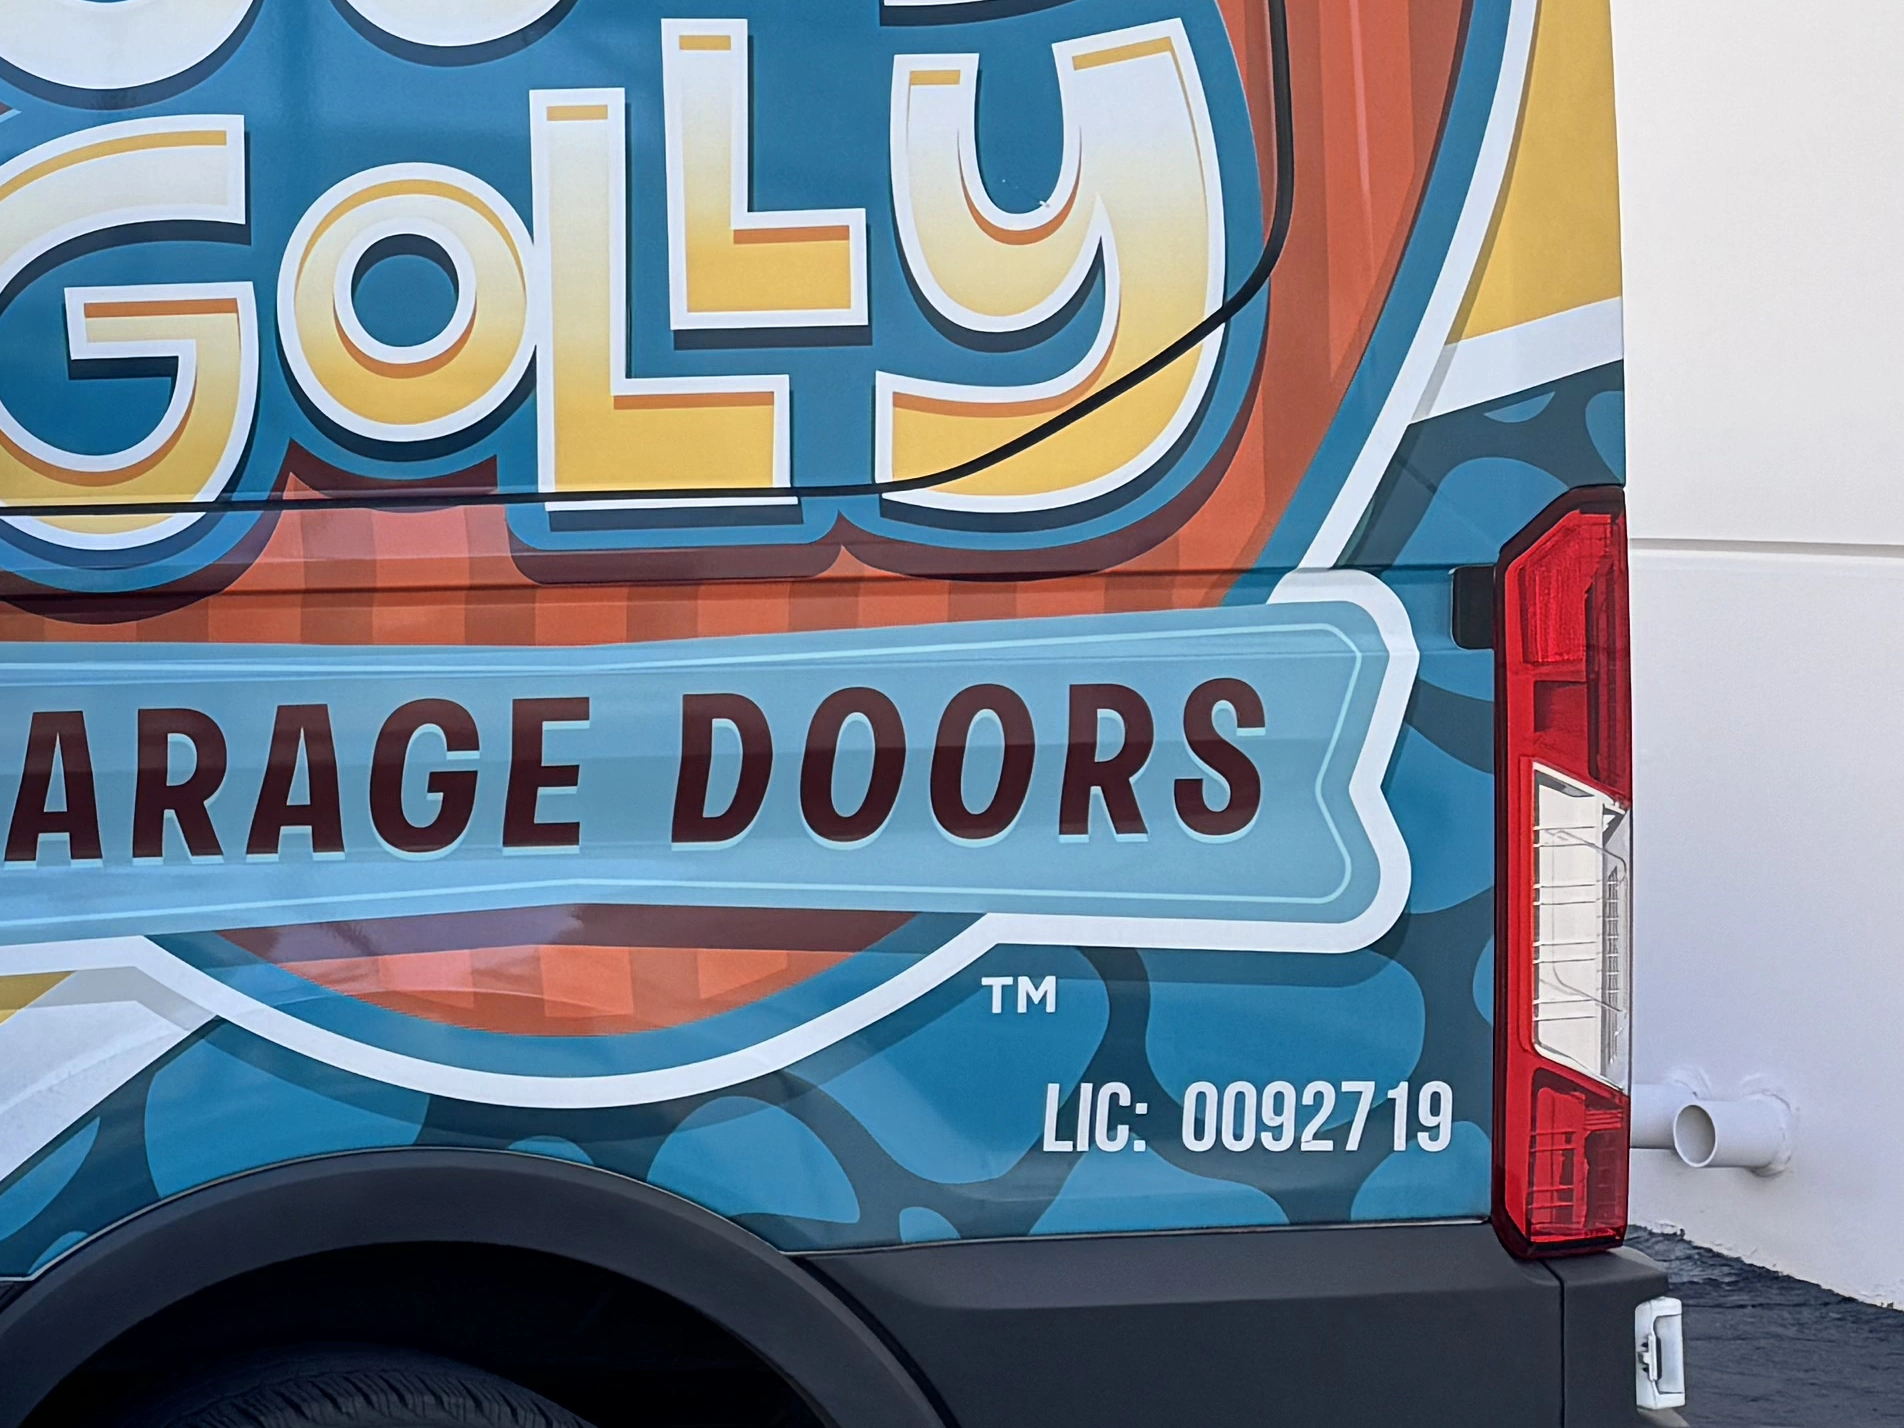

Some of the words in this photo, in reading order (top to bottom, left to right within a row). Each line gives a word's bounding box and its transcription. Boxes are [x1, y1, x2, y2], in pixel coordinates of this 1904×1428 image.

[671, 678, 1266, 850] DOORS
[981, 975, 1057, 1014] TM
[1043, 1081, 1148, 1152] LIC:
[1182, 1080, 1454, 1152] 0092719
